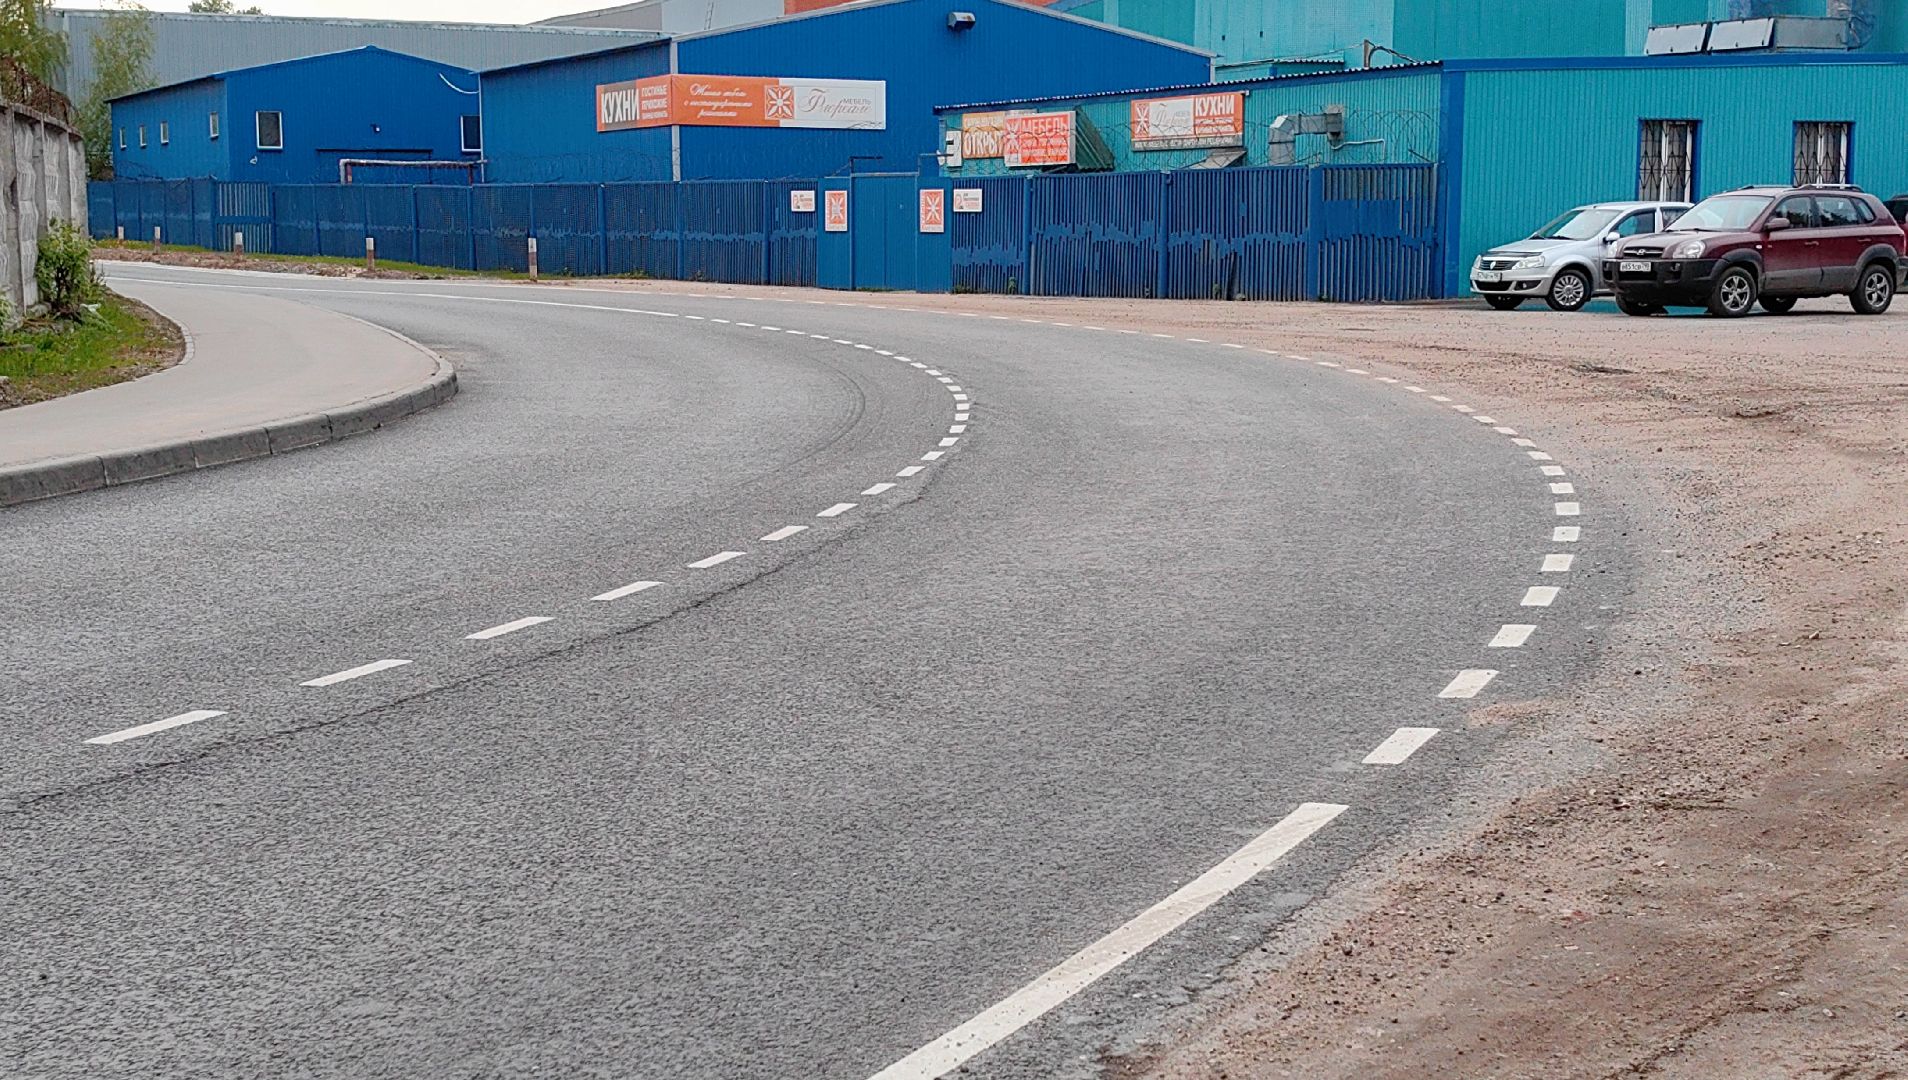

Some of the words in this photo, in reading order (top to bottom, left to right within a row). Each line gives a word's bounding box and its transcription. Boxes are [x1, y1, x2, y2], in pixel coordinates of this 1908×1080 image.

[601, 88, 640, 124] КУХНИ
[1195, 94, 1235, 117] КУХНИ
[1021, 115, 1069, 137] МЕБЕЛЬ
